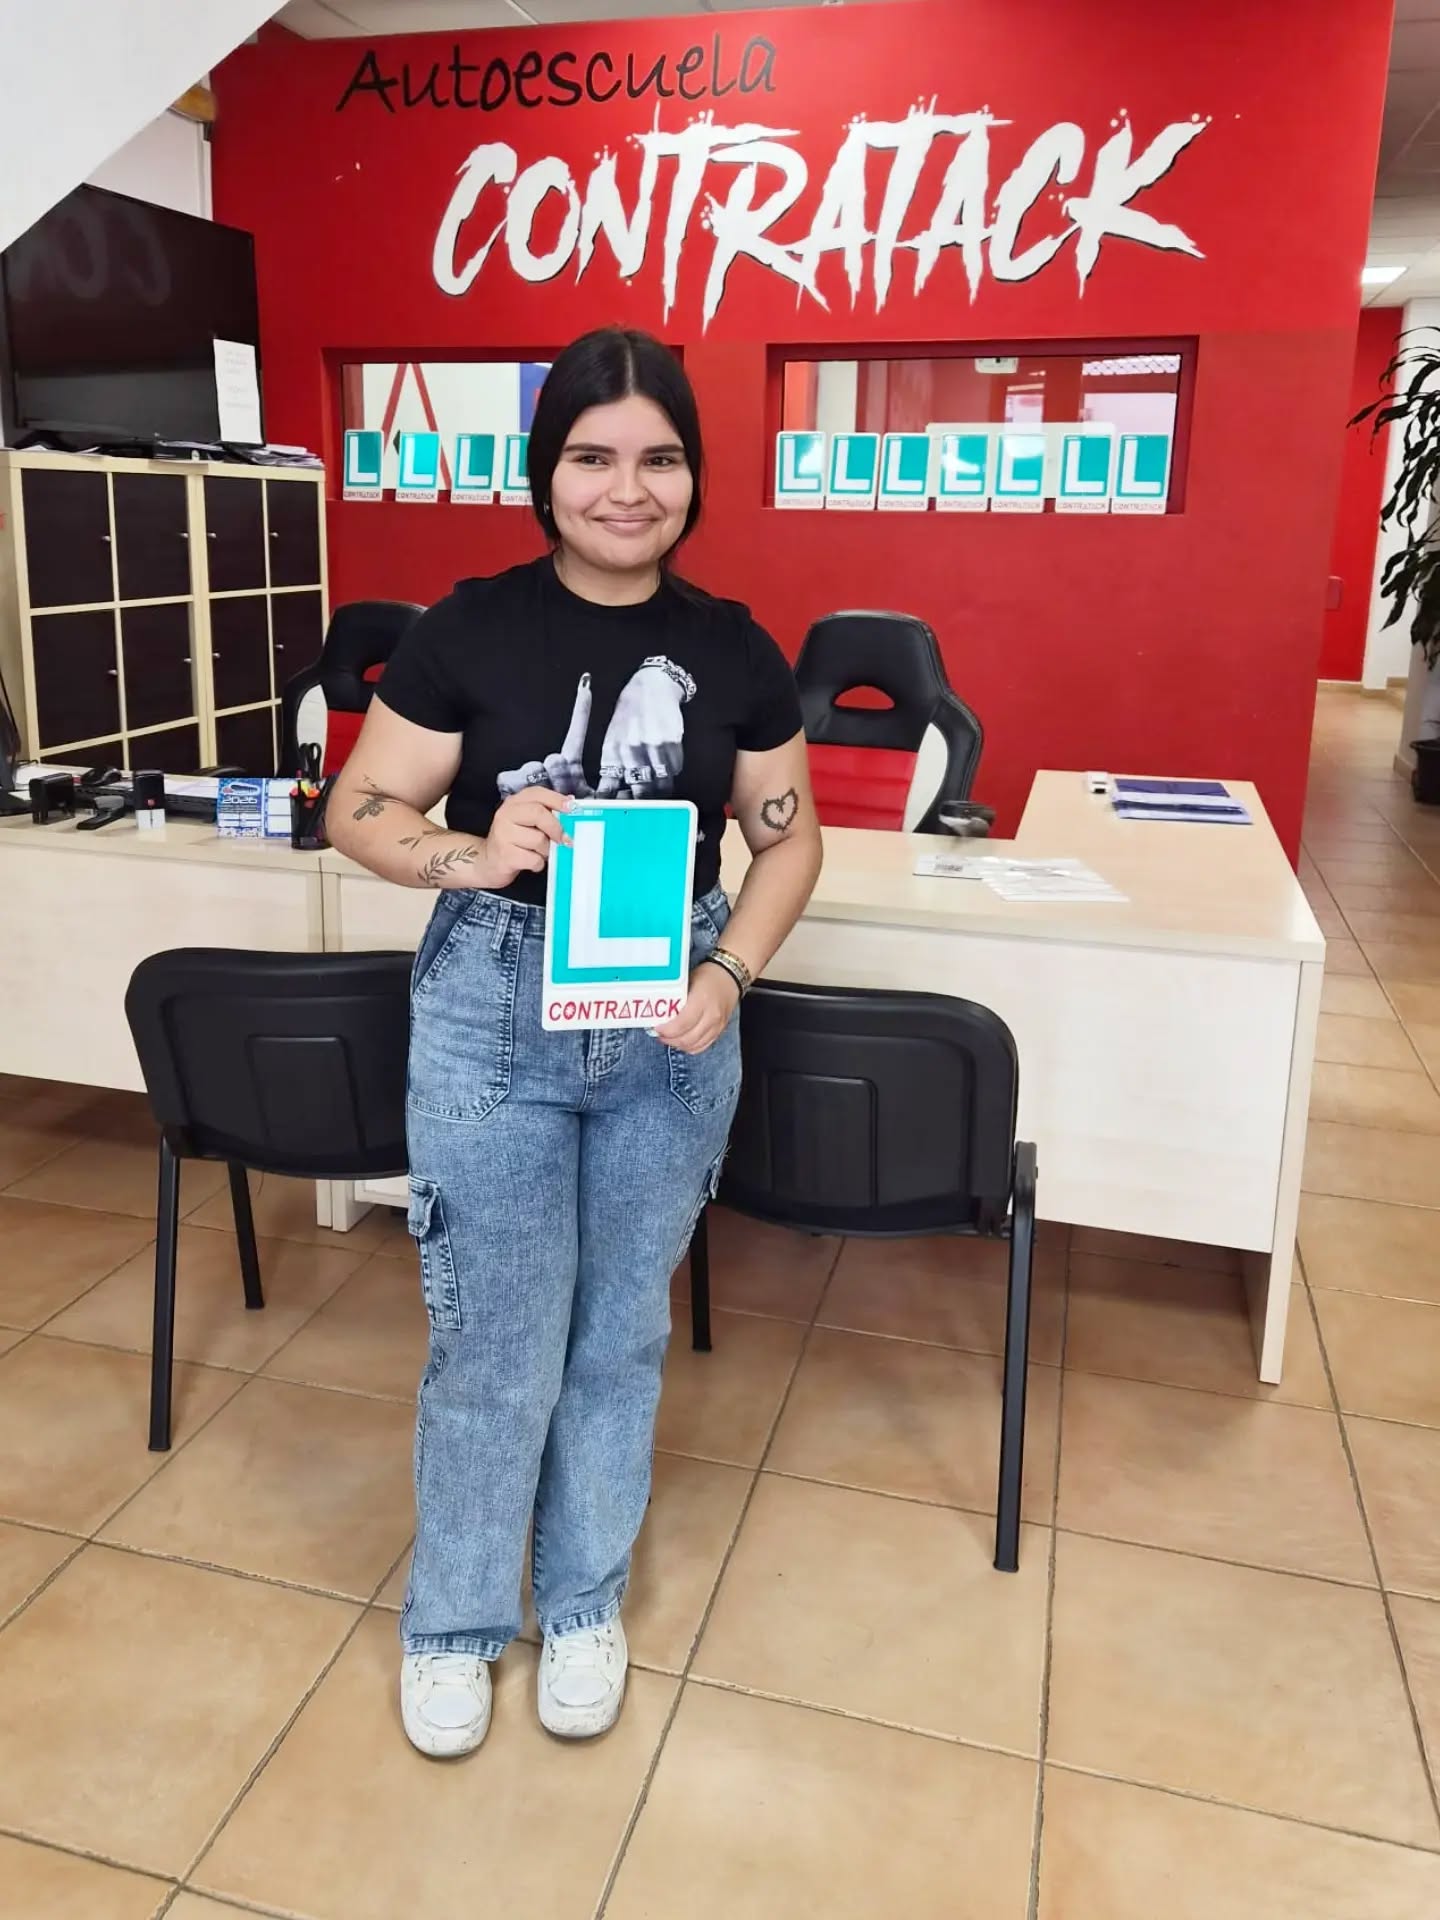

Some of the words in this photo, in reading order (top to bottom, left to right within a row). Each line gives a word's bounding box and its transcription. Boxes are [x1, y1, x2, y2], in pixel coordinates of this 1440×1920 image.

[336, 32, 777, 113] Autoescuela
[433, 98, 1207, 335] CONTRATACK
[349, 436, 378, 483] L
[402, 436, 433, 484] L
[458, 438, 490, 486] L
[783, 438, 820, 490] L
[834, 439, 871, 490] L
[886, 439, 923, 492] L
[1065, 440, 1105, 492] L
[1121, 439, 1162, 493] L
[567, 820, 671, 968] L
[549, 999, 681, 1021] CONTRATACK
